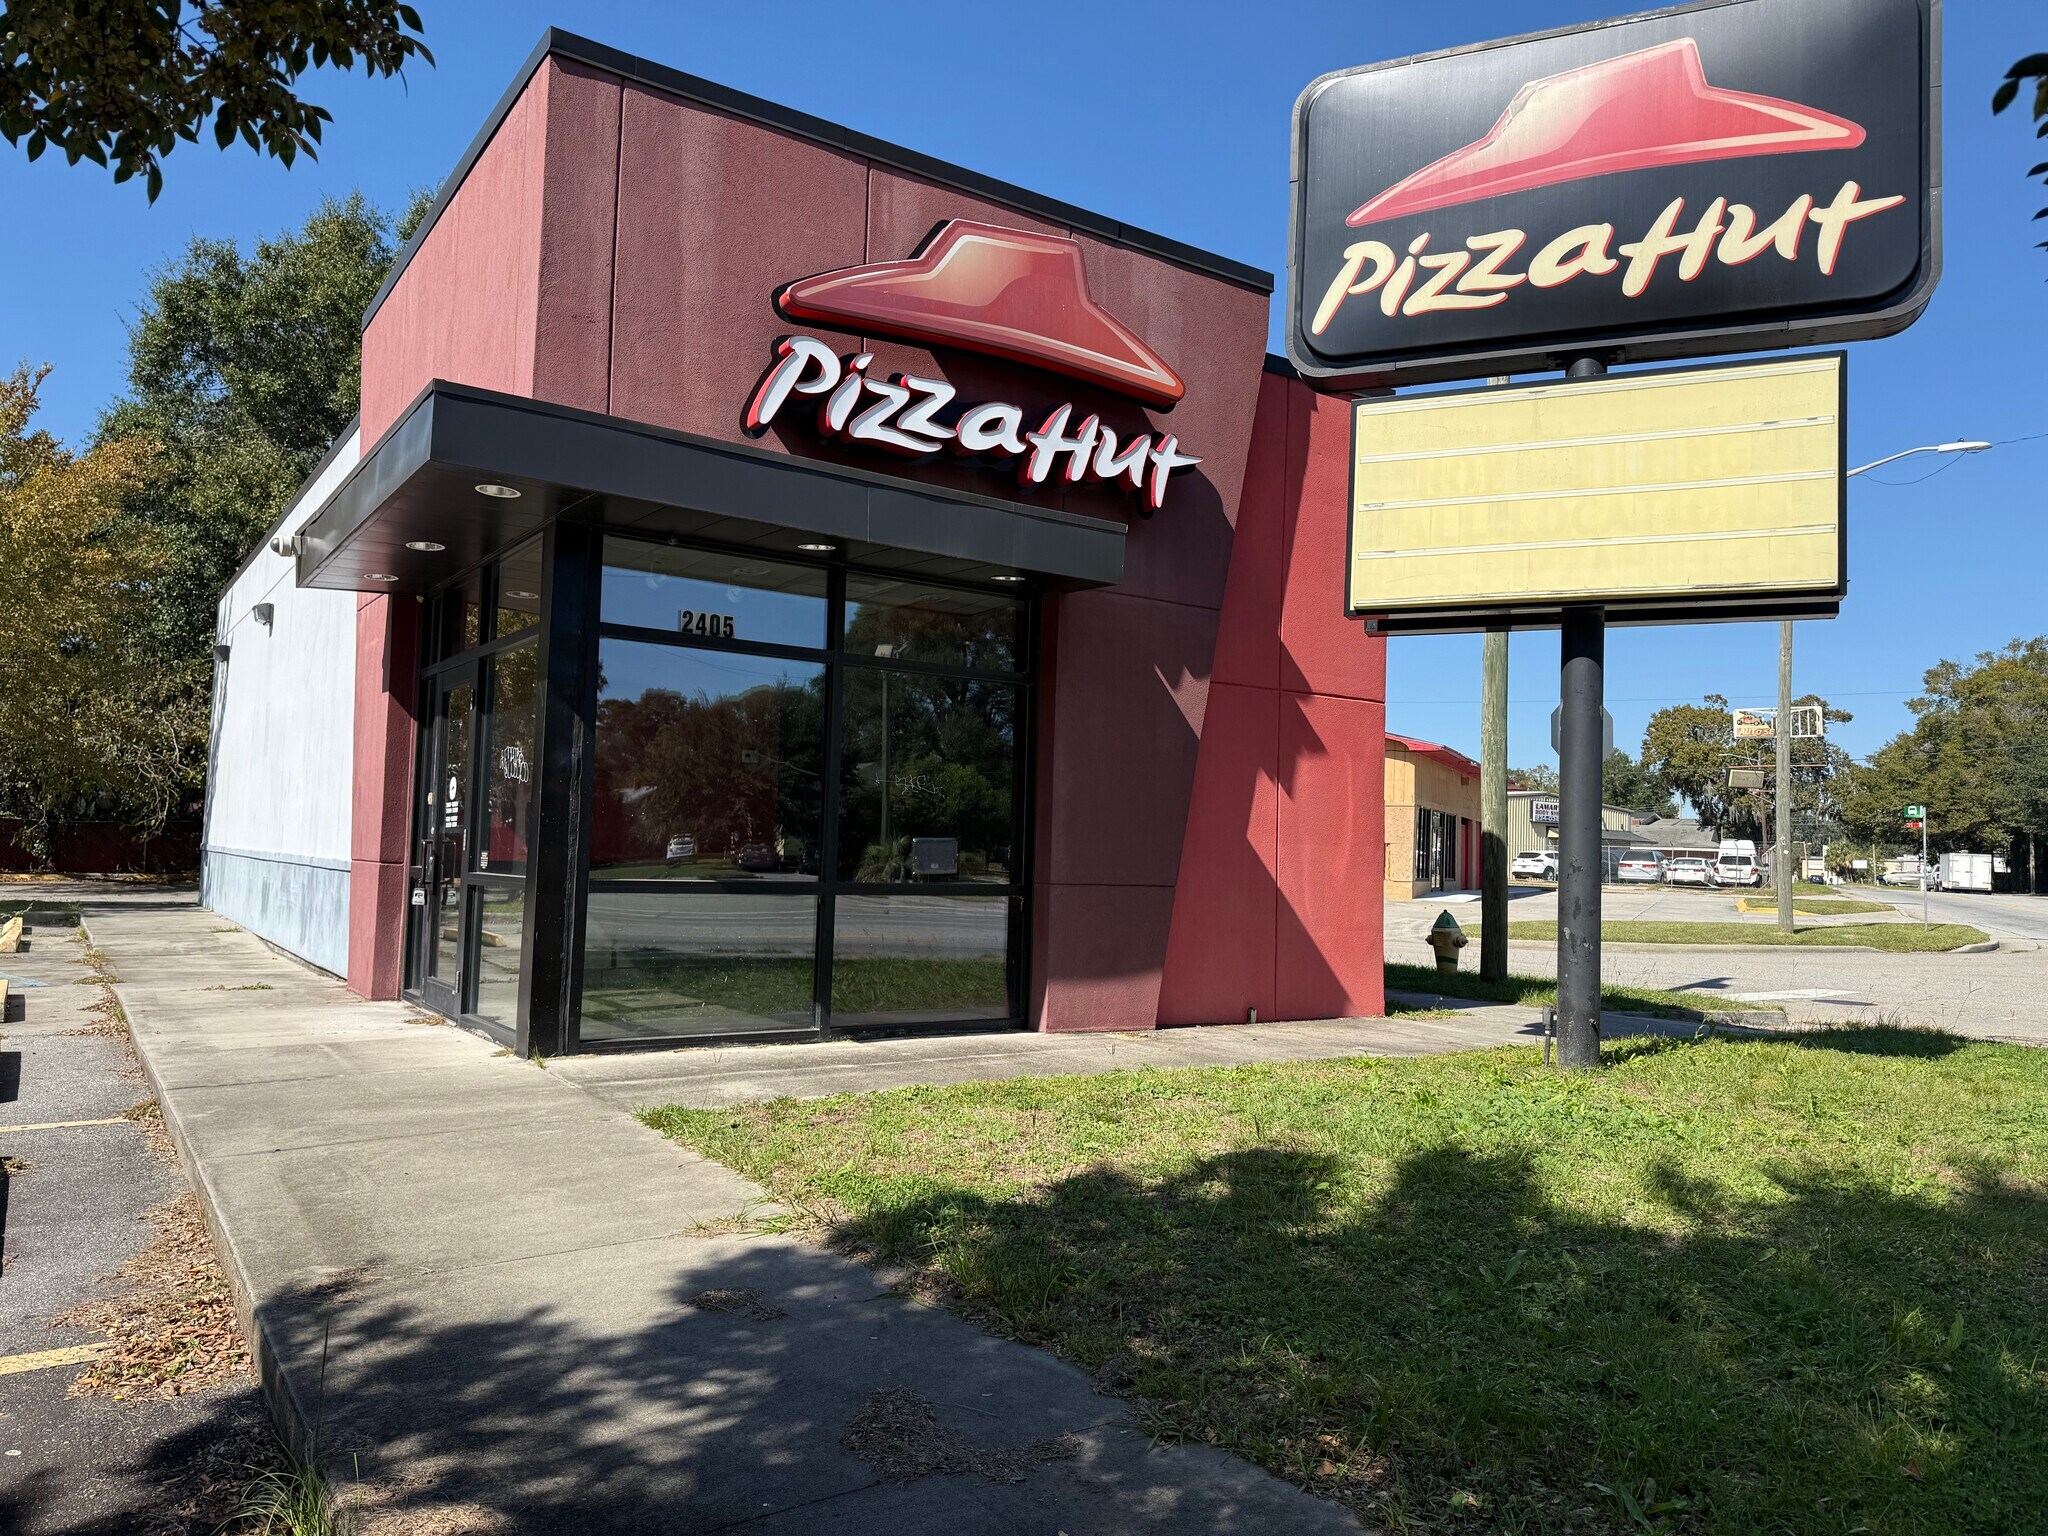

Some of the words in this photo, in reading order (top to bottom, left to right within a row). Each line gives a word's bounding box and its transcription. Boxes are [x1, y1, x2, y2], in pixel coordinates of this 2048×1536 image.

[1311, 222, 1618, 335] Pizza
[1619, 181, 1905, 298] Hut
[747, 336, 1027, 453] Pizza
[1024, 402, 1204, 508] Hut
[681, 610, 734, 638] 2405
